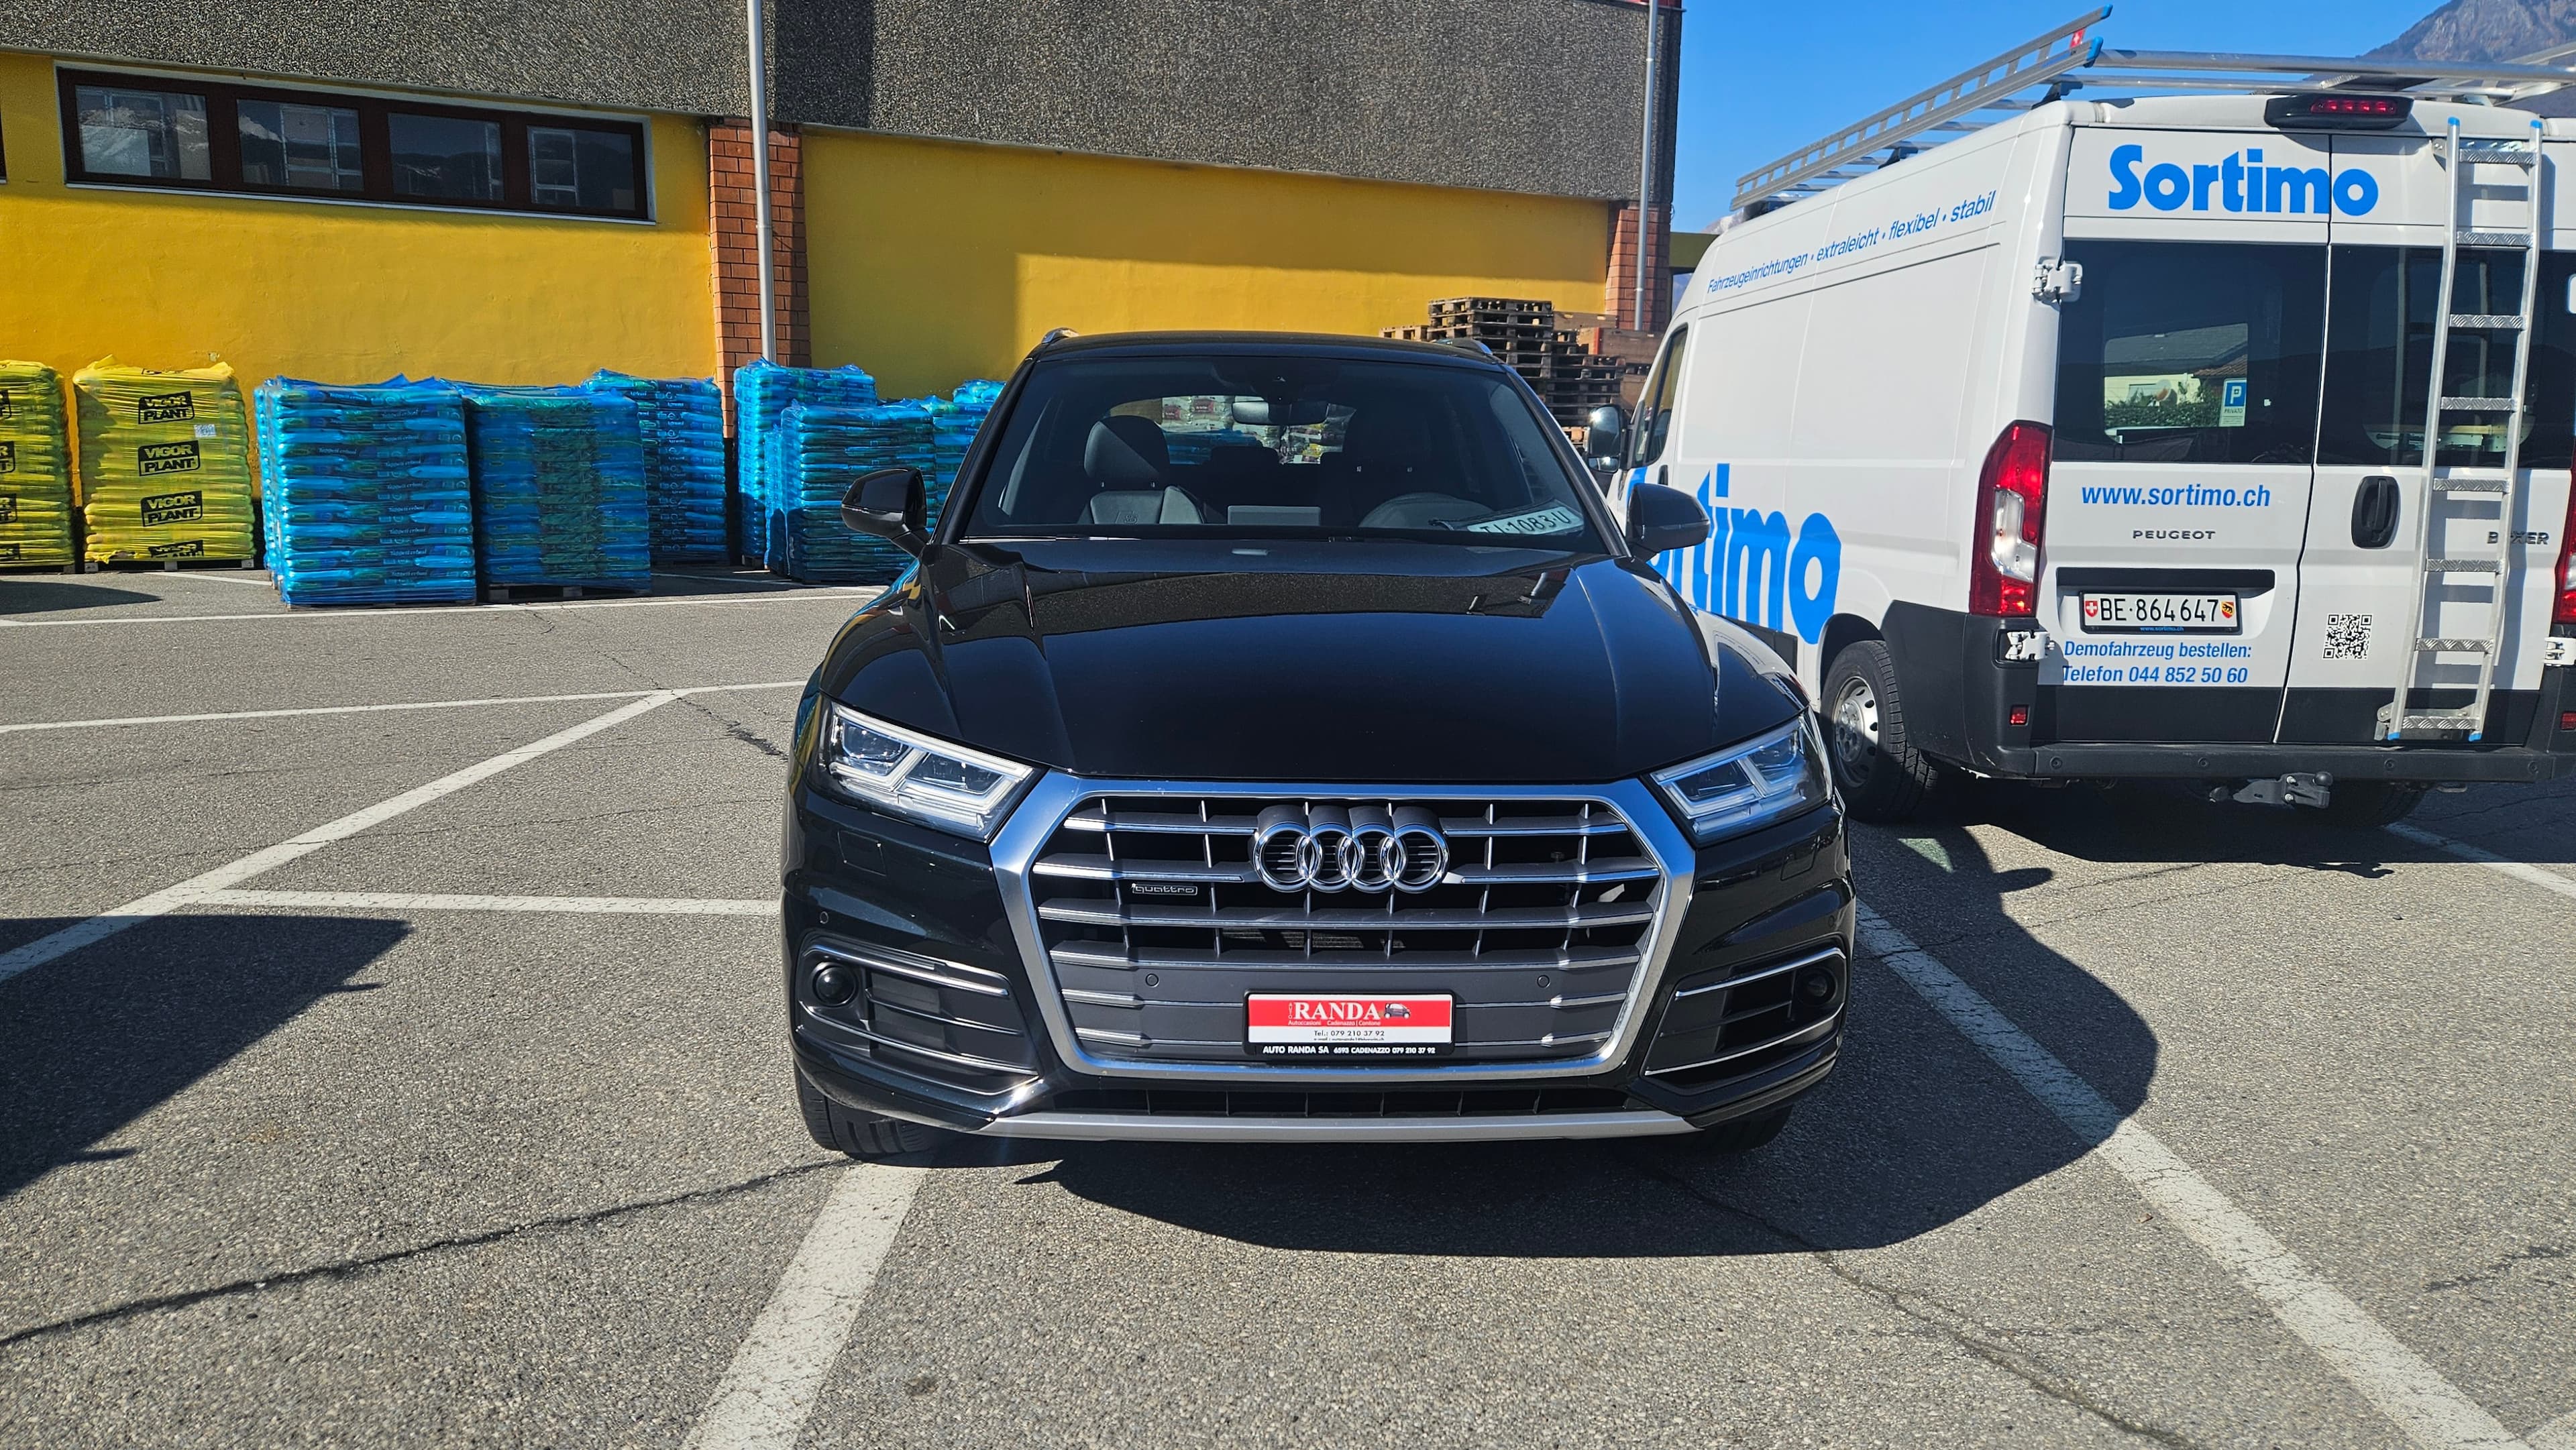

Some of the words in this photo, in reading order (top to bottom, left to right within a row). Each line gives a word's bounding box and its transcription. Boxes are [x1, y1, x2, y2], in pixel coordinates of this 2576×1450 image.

[2108, 144, 2379, 217] Sortimo
[1707, 254, 1807, 294] Fahrzeugeinrichtungen
[1817, 230, 1878, 262] extraleicht
[1889, 208, 1940, 241] flexibel
[1951, 190, 1996, 222] stabil
[144, 408, 190, 422] PLANT
[144, 444, 193, 459] VIGOR
[144, 458, 195, 473] PLANT
[148, 494, 196, 510] VIGOR
[2082, 484, 2271, 507] www.sortimo.ch
[148, 508, 198, 524] PLANT
[2133, 530, 2216, 539] PEUGEOT
[2487, 531, 2550, 545] BXER
[1626, 463, 1841, 645] timo
[2064, 640, 2174, 660] Demofahrzeug
[2180, 642, 2251, 658] bestellen:
[2062, 665, 2123, 682] Telefon
[2129, 666, 2159, 683] 044
[2165, 667, 2196, 683] 852
[2201, 667, 2222, 683] 50
[2226, 667, 2249, 683] 60
[1135, 885, 1194, 894] quattro
[1293, 1001, 1381, 1020] RANDA
